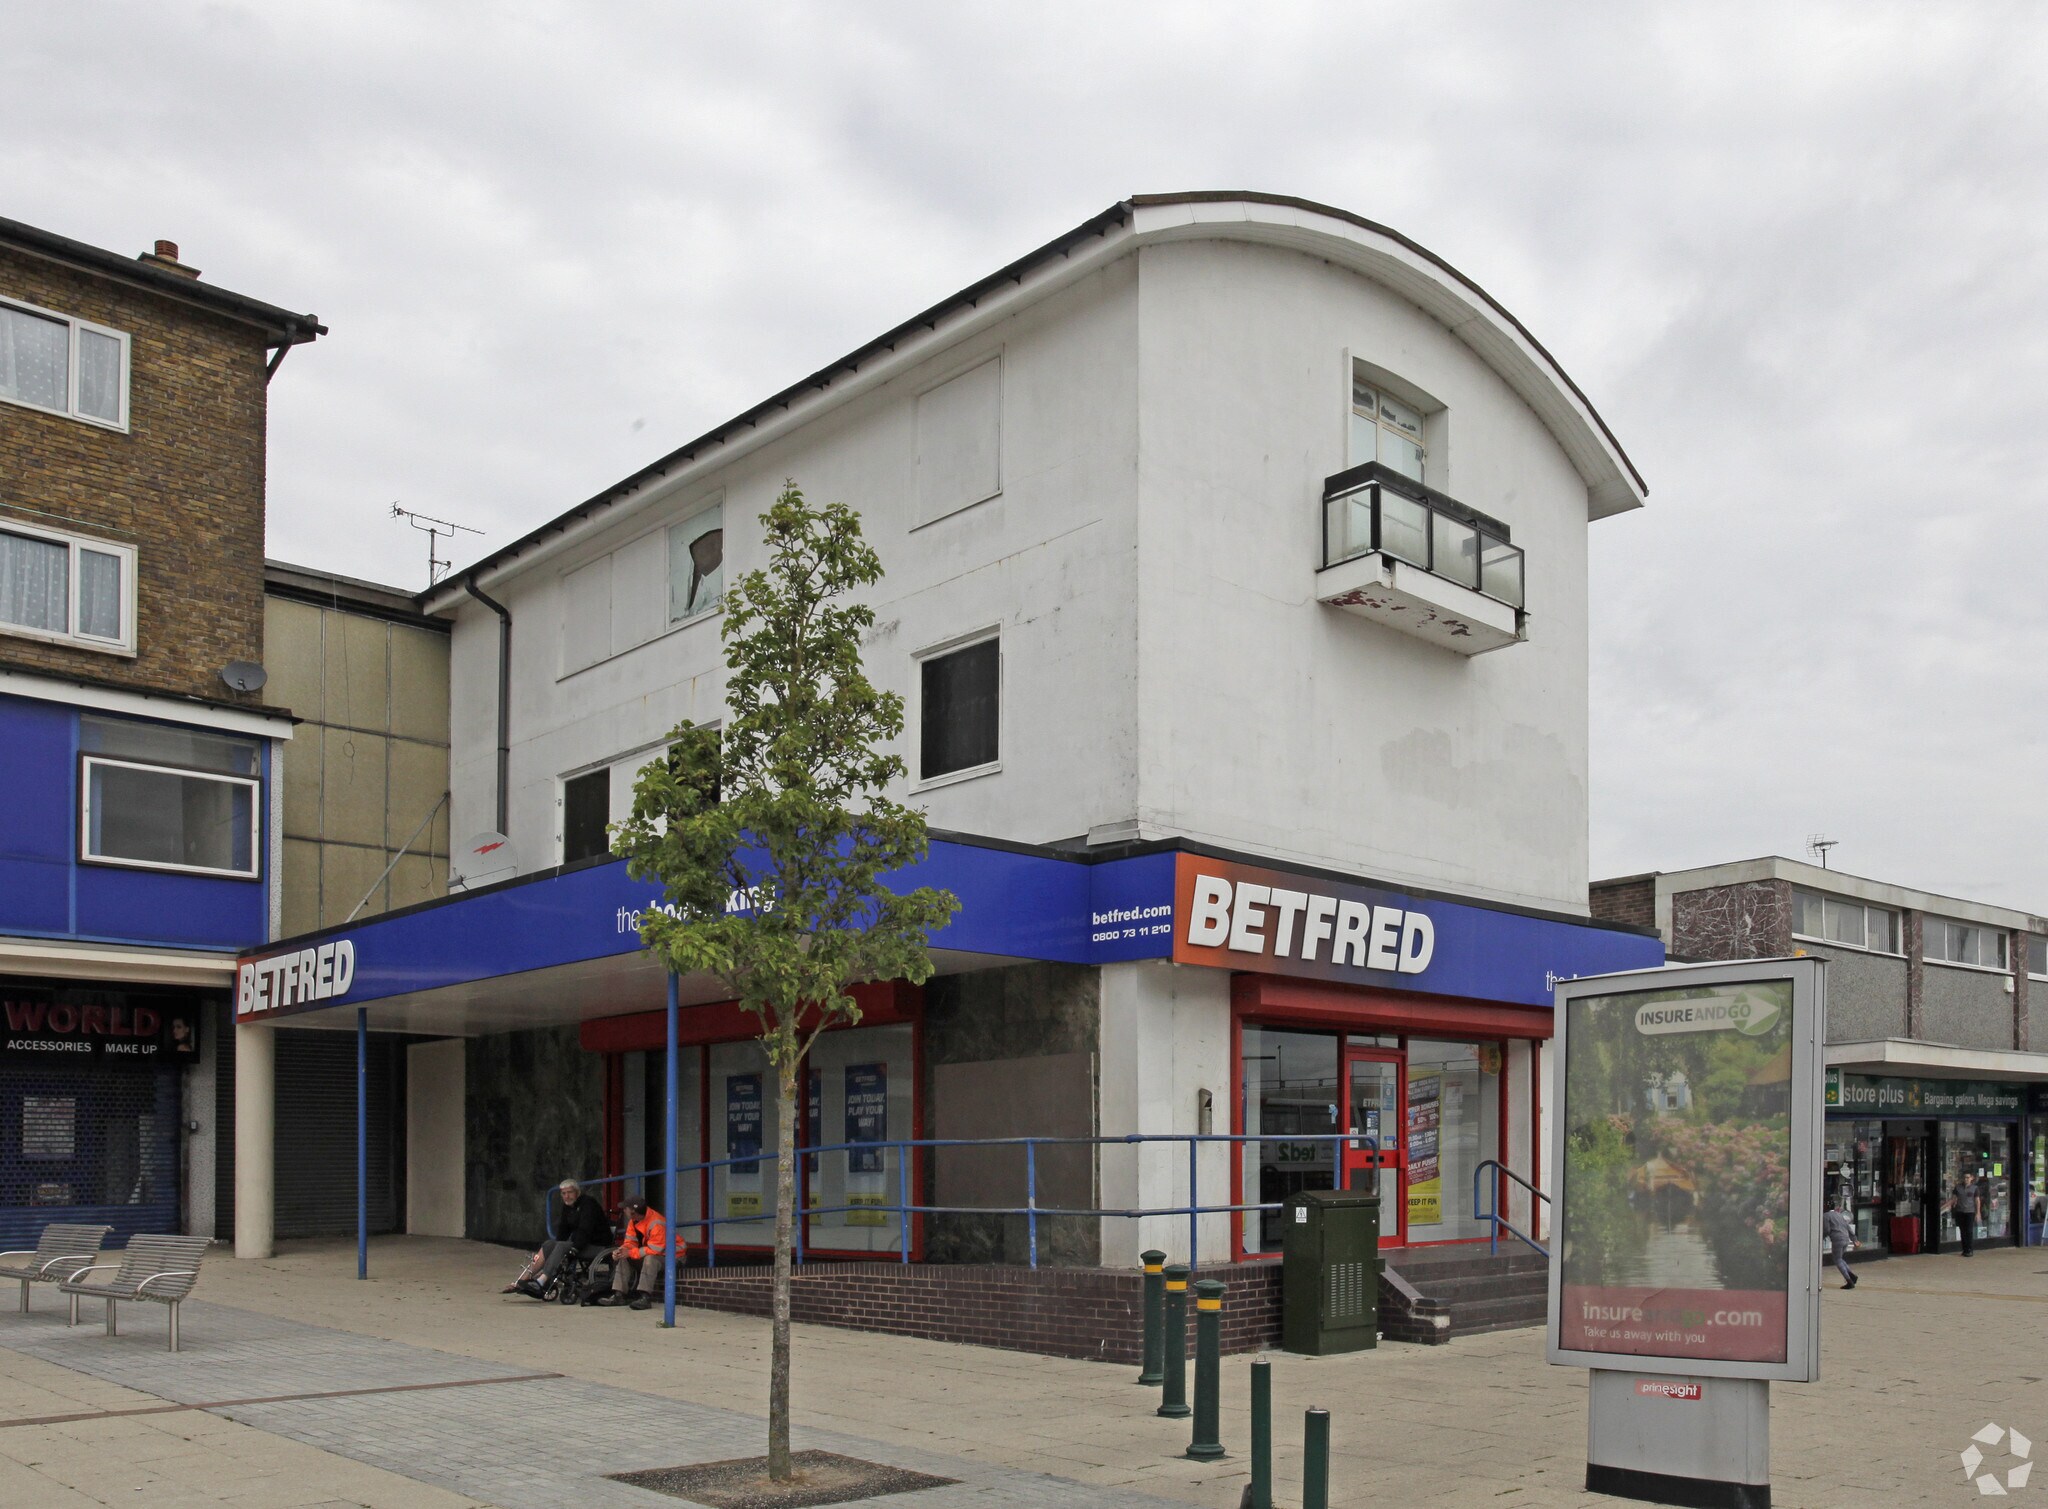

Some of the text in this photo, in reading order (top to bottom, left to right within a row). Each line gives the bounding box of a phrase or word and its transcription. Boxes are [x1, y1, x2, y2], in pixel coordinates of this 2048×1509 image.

[616, 906, 641, 933] the
[1092, 905, 1171, 925] betfred.com
[1187, 874, 1435, 974] BETFRED
[1092, 924, 1171, 942] 0800 73 11 210
[238, 939, 355, 1015] BETFRED
[4, 1001, 161, 1036] WORLD
[1640, 1004, 1751, 1026] INSUREANDGO
[7, 1040, 158, 1054] ACCESSORIES MAKE UP
[848, 1095, 861, 1105] JOIN
[1844, 1084, 1904, 1108] store plus
[1924, 1092, 2018, 1109] Bargains galore, Mega savings
[729, 1112, 760, 1121] PLAY YOUR
[848, 1105, 883, 1116] PLAY YOUR
[1422, 1198, 1427, 1206] IT
[1583, 1326, 1706, 1345] Take us away with you
